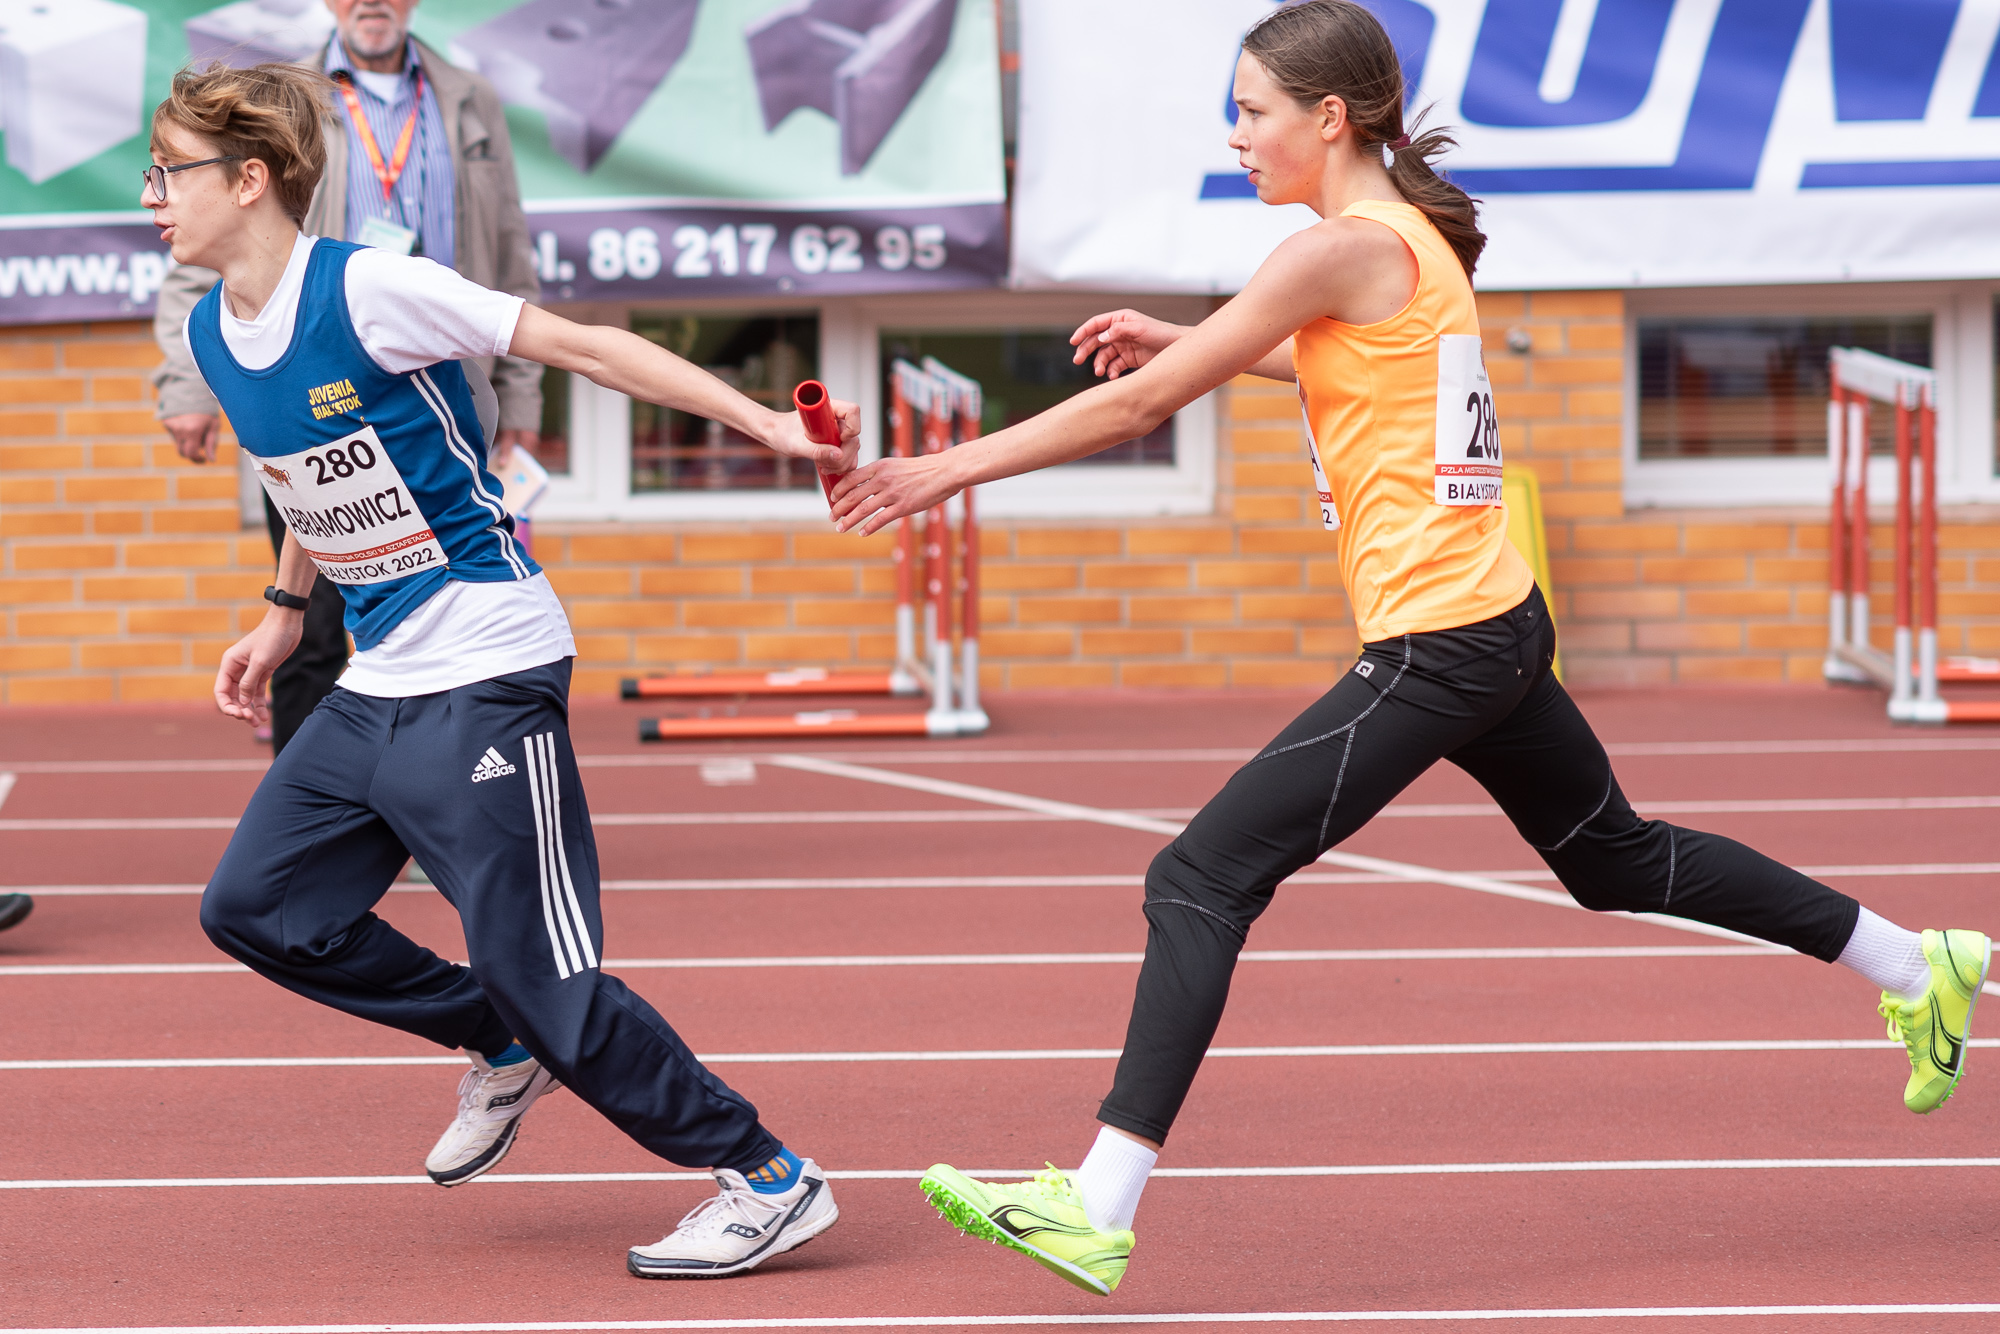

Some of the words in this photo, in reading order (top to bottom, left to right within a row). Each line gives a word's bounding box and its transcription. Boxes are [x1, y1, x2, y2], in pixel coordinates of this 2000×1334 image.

[588, 226, 662, 281] 86
[672, 223, 777, 278] 217
[790, 224, 863, 274] 62
[875, 224, 947, 271] 95
[308, 378, 356, 406] JUVENIA
[1467, 391, 1499, 461] 286
[305, 440, 376, 486] 280
[1440, 465, 1464, 474] PZLA
[283, 486, 412, 538] ABRAMOWICZ
[353, 548, 378, 560] POLSKI
[385, 532, 431, 552] SZTAFETACH
[391, 547, 436, 572] 2022
[471, 763, 517, 783] adidas
